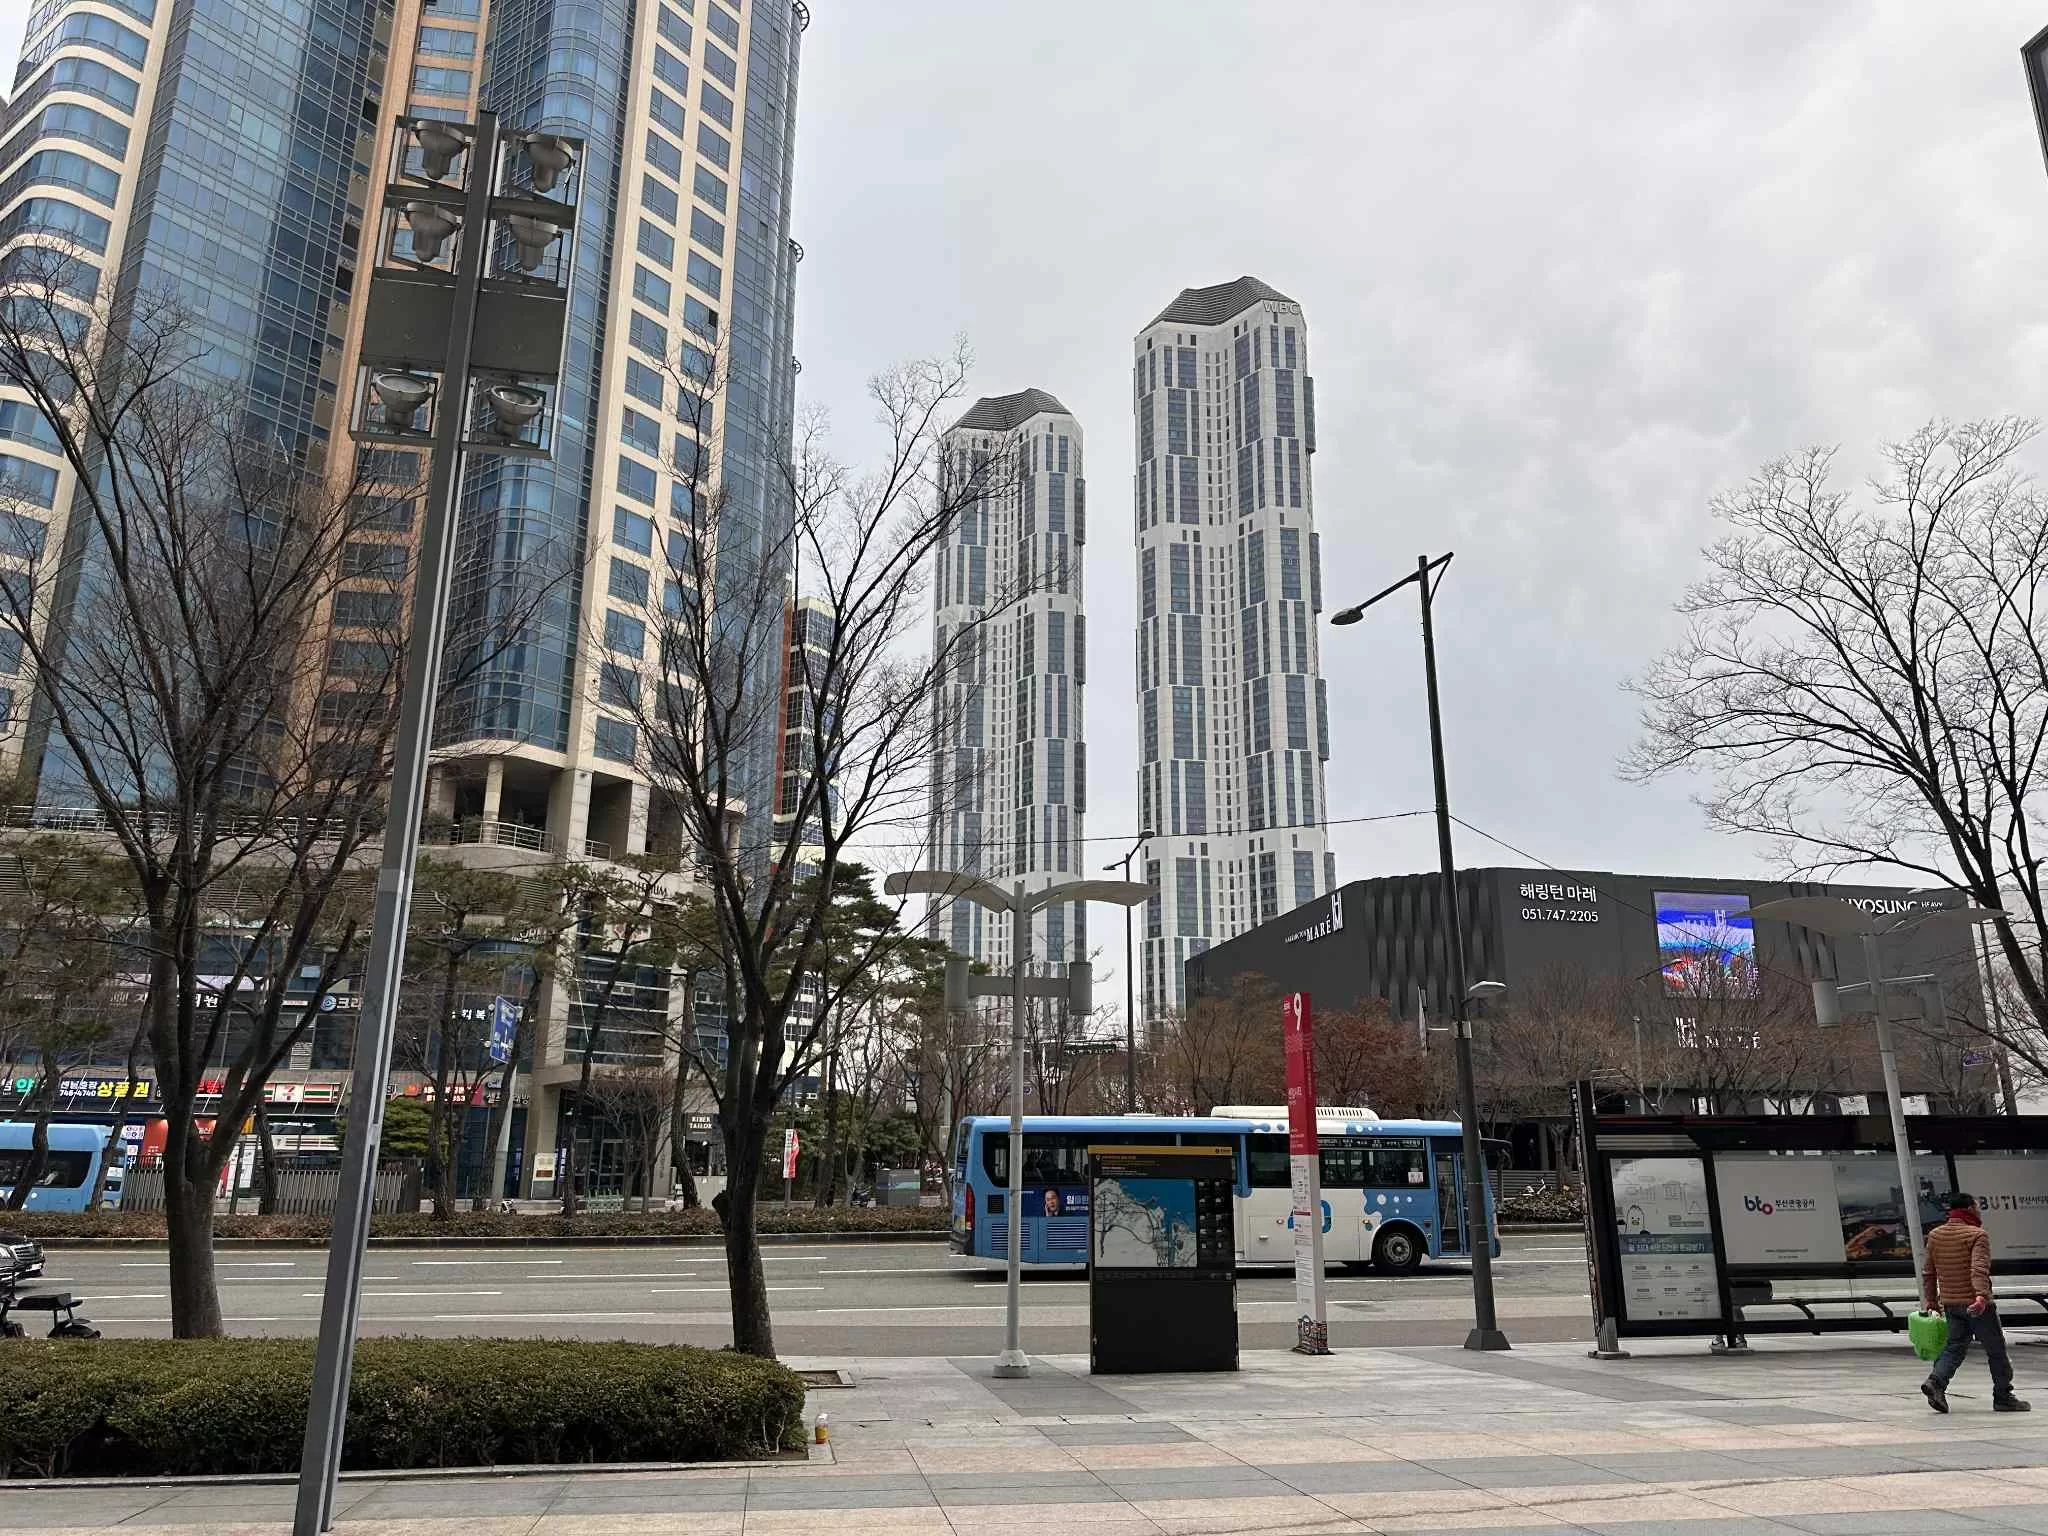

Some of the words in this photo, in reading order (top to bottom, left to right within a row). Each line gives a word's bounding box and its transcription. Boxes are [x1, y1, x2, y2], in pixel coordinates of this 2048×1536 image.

[1263, 301, 1301, 314] WBC
[1520, 883, 1564, 900] 해링턴
[1567, 885, 1596, 902] 마레
[1522, 908, 1598, 922] 051.747.2205
[1744, 1195, 1773, 1215] bto
